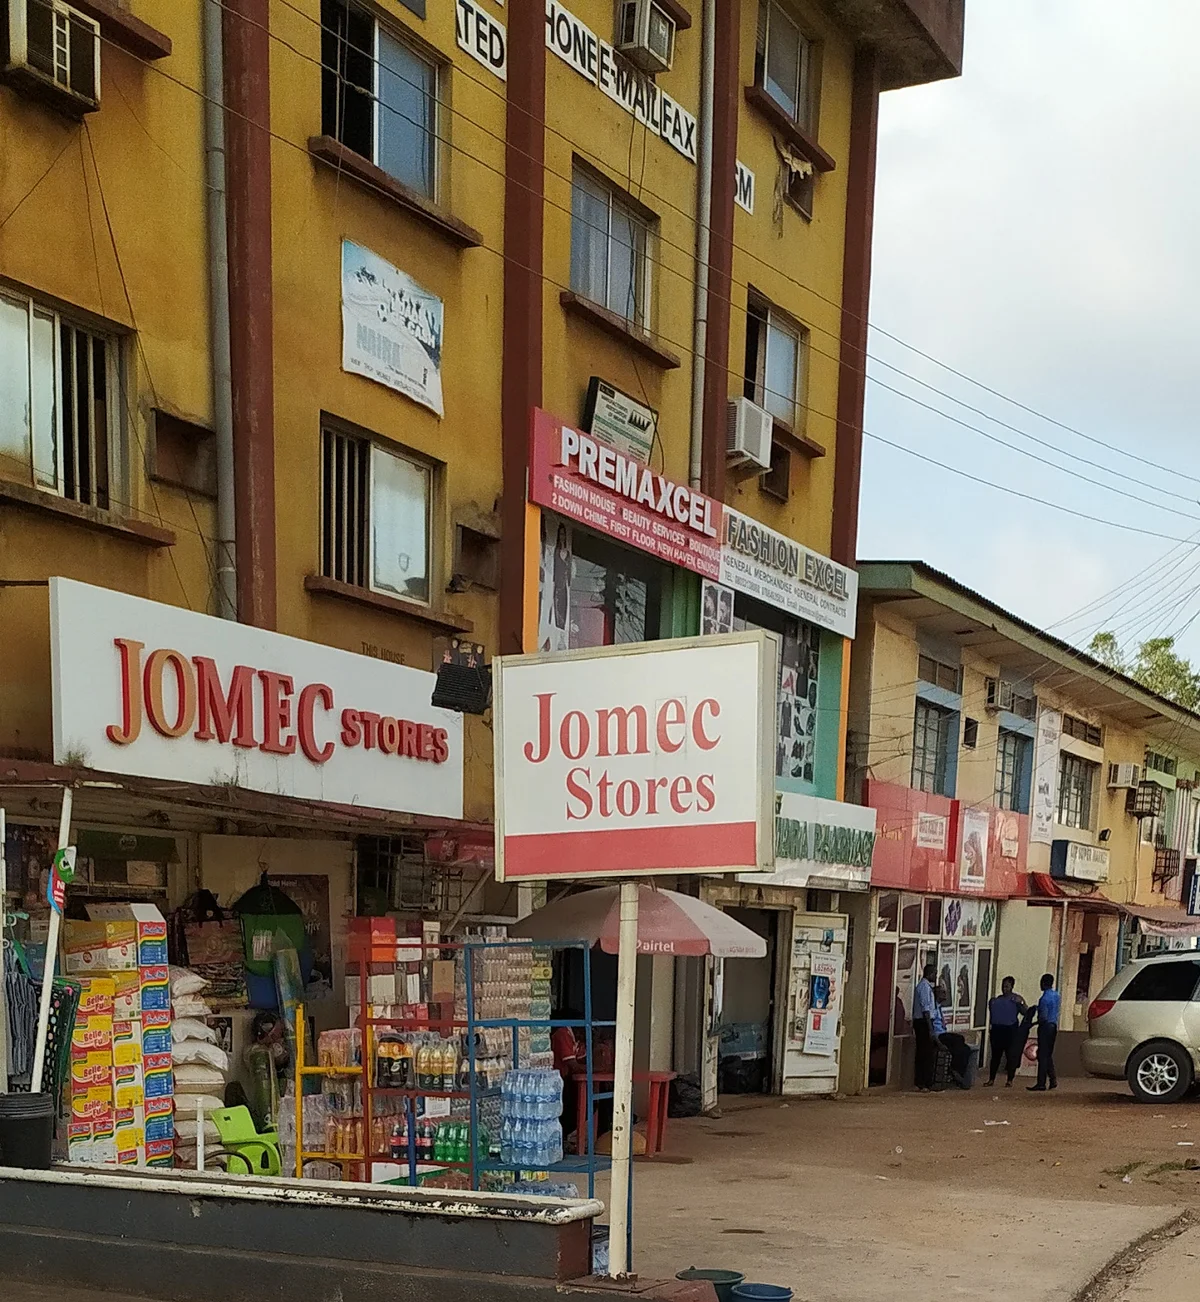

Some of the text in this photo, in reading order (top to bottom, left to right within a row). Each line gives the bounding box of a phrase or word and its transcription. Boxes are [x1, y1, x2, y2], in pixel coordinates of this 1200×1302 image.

[456, 0, 505, 68] TED
[663, 96, 696, 157] FAX
[552, 492, 558, 504] 2
[557, 494, 583, 517] DOWN
[610, 519, 630, 538] FIRST
[632, 527, 656, 550] FLOOR
[553, 474, 721, 562] FASHION HOUSE BEAUTY SERVICES BOUTIQUE
[560, 425, 717, 538] PREMAXCEL
[727, 513, 849, 600] FASHION EXCEL
[105, 637, 449, 765] JOMEC STORES
[523, 692, 721, 764] Jomec
[565, 767, 716, 821] Stores
[643, 940, 675, 952] airtel
